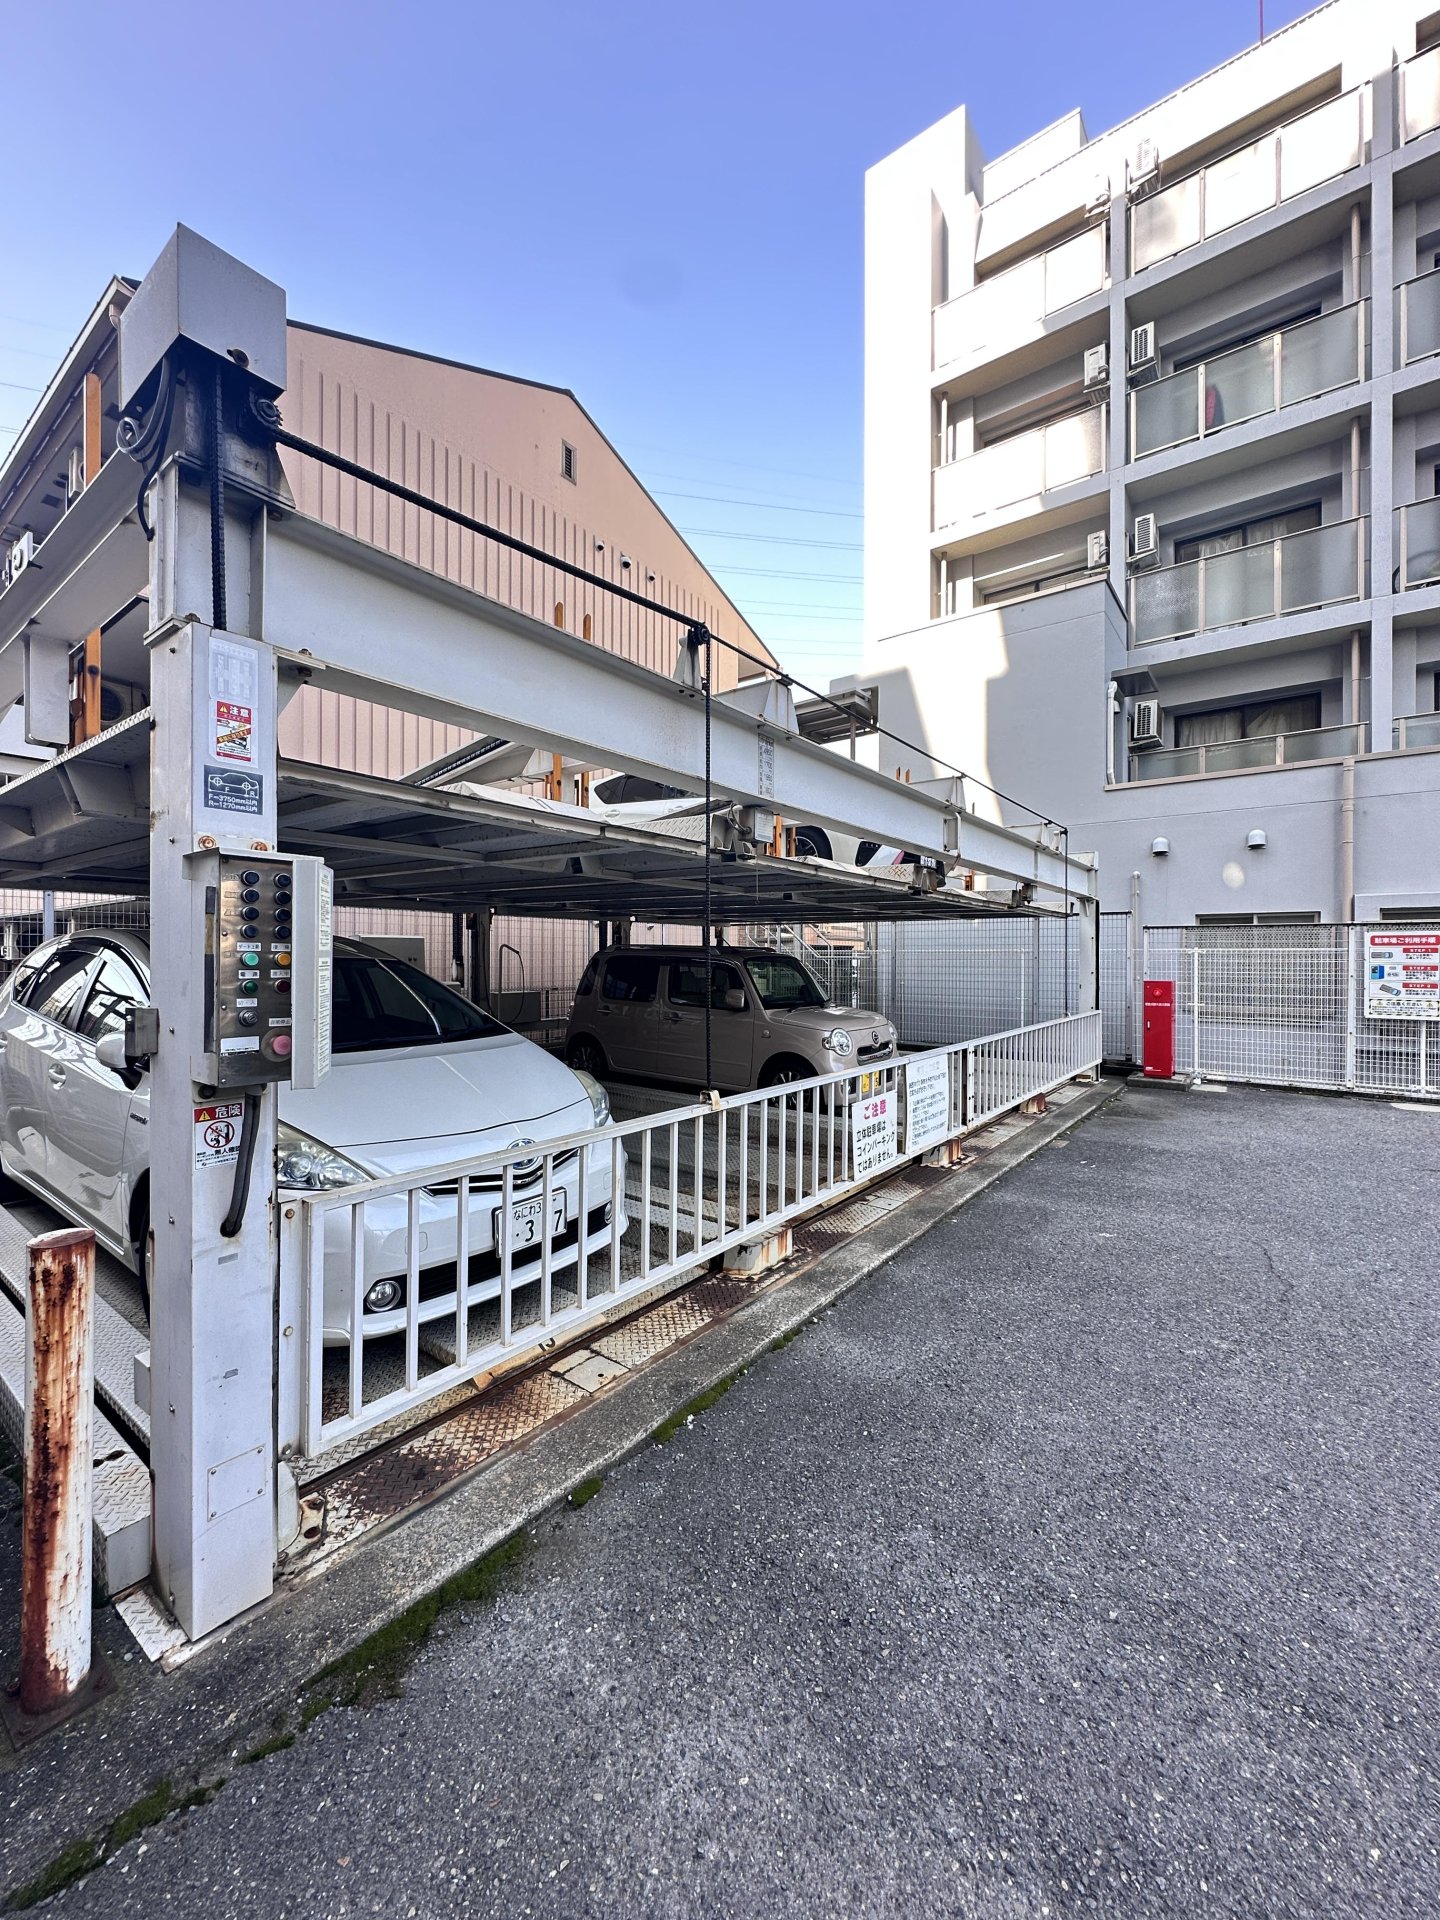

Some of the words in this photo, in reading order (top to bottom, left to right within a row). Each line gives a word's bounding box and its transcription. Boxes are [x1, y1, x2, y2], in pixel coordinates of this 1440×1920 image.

[229, 705, 249, 718] 注意
[215, 1104, 241, 1118] 危険
[863, 1098, 888, 1121] ご注意
[856, 1120, 887, 1143] 立体駐車場は
[856, 1130, 896, 1158] コインパーキング
[856, 1148, 894, 1174] ではありません。
